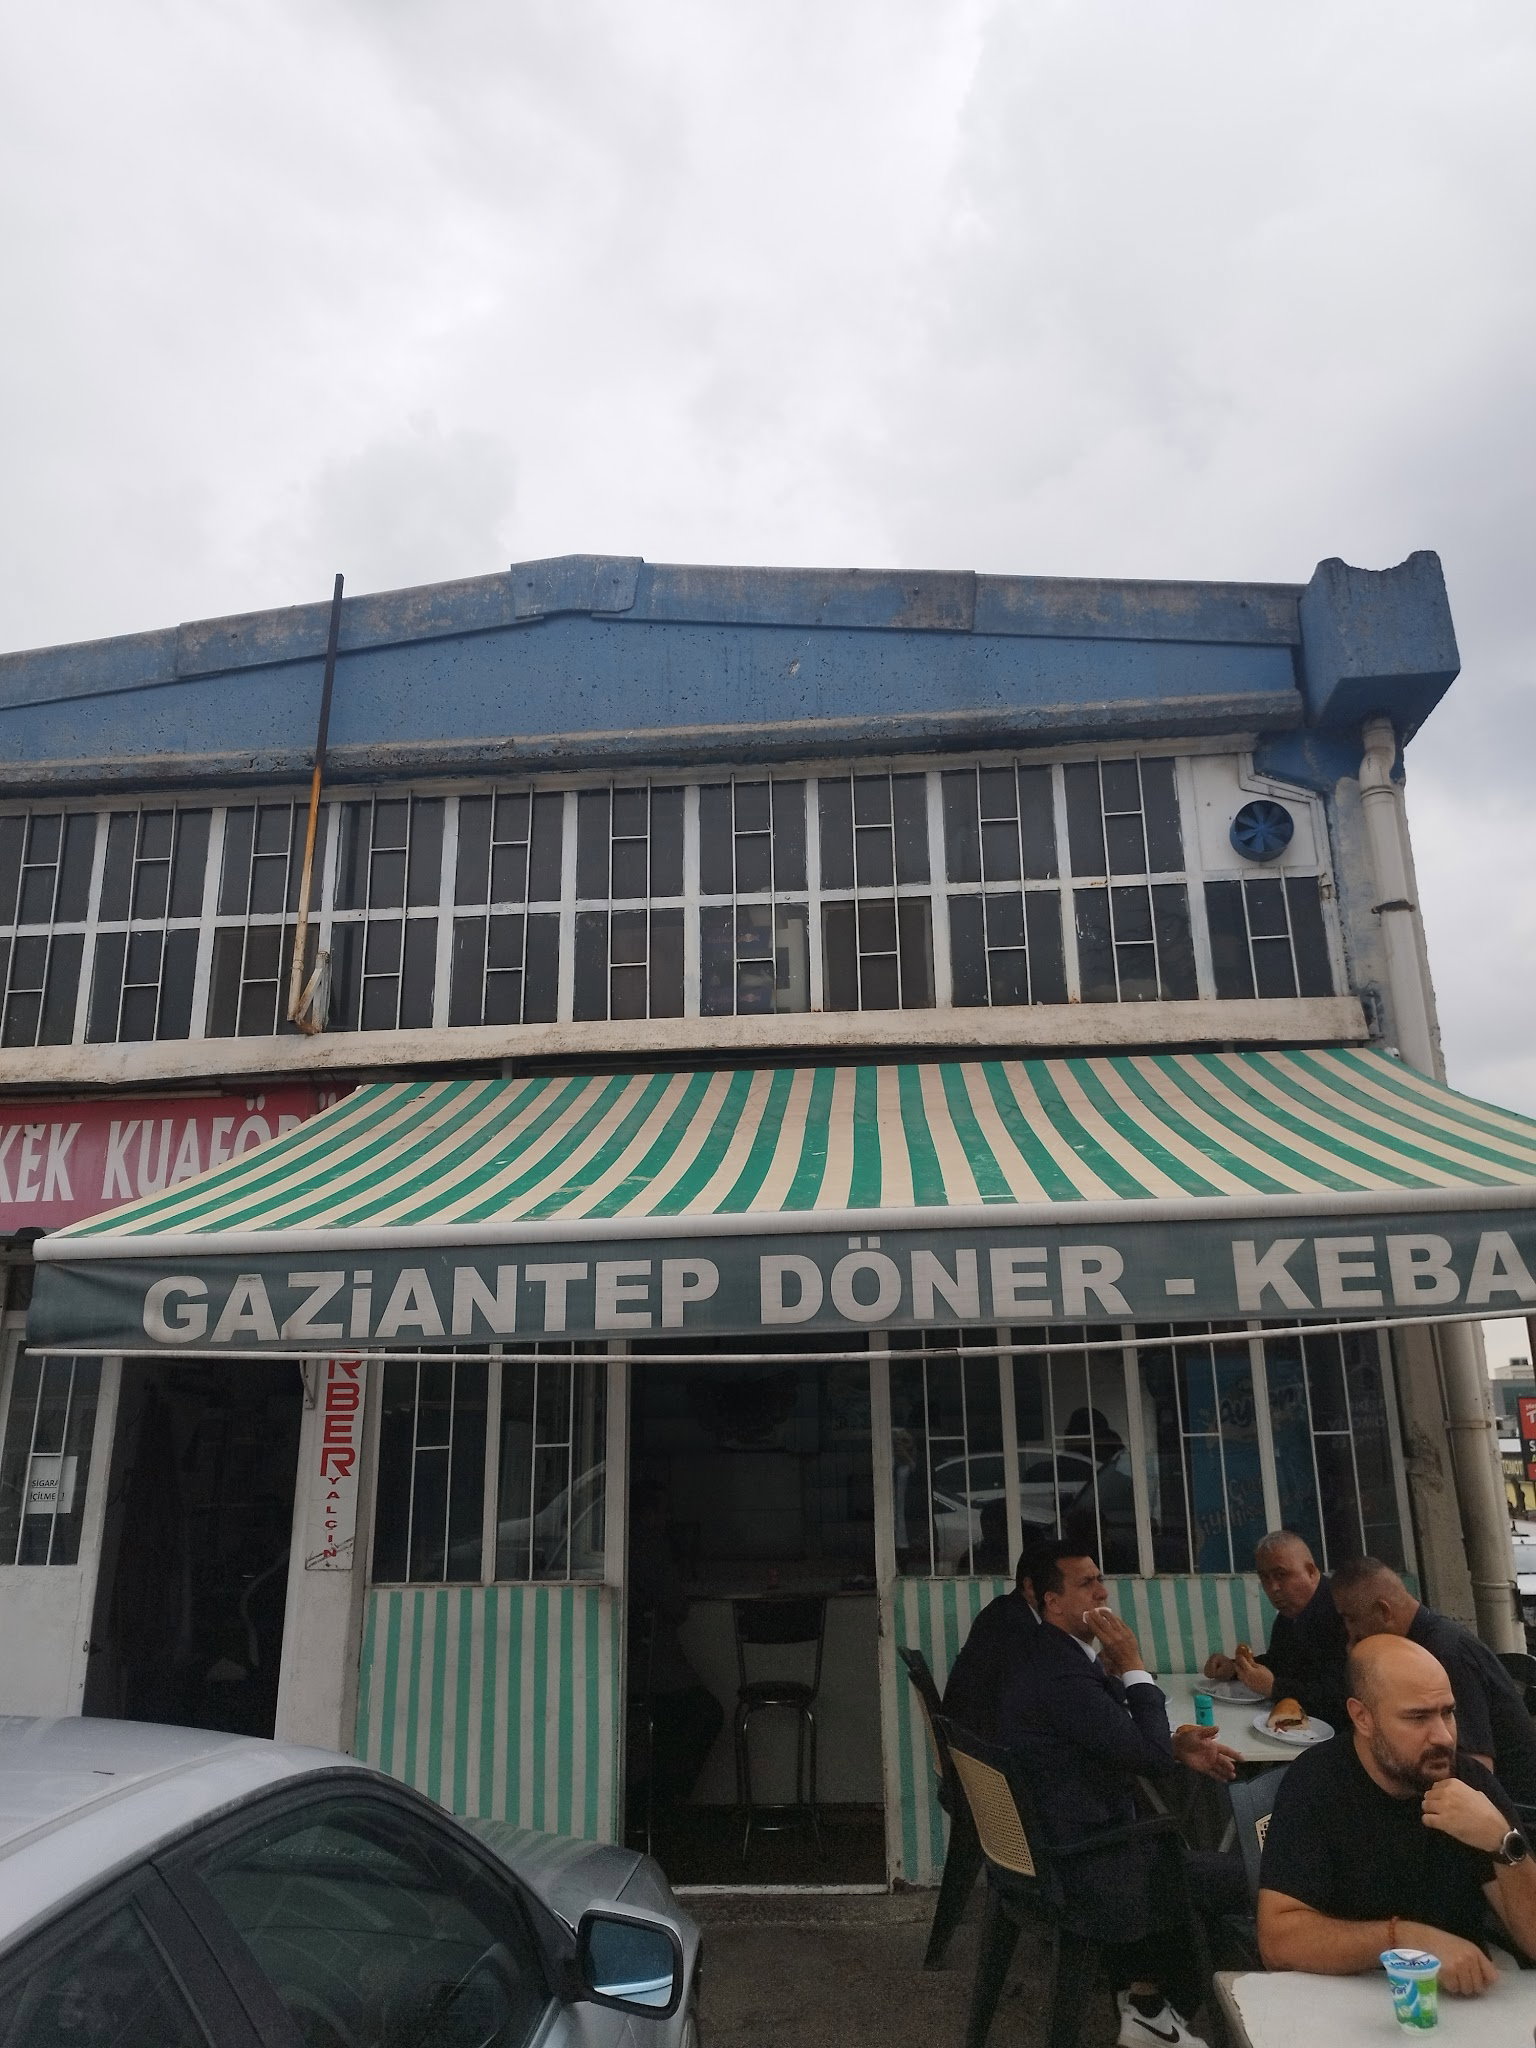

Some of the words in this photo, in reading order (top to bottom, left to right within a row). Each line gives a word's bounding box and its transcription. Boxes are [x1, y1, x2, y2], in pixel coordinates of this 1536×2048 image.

[101, 1092, 337, 1200] KUAFÖ
[760, 1236, 1134, 1325] DÖNER
[1231, 1230, 1536, 1312] KEBA
[324, 1476, 342, 1558] YALÇIN
